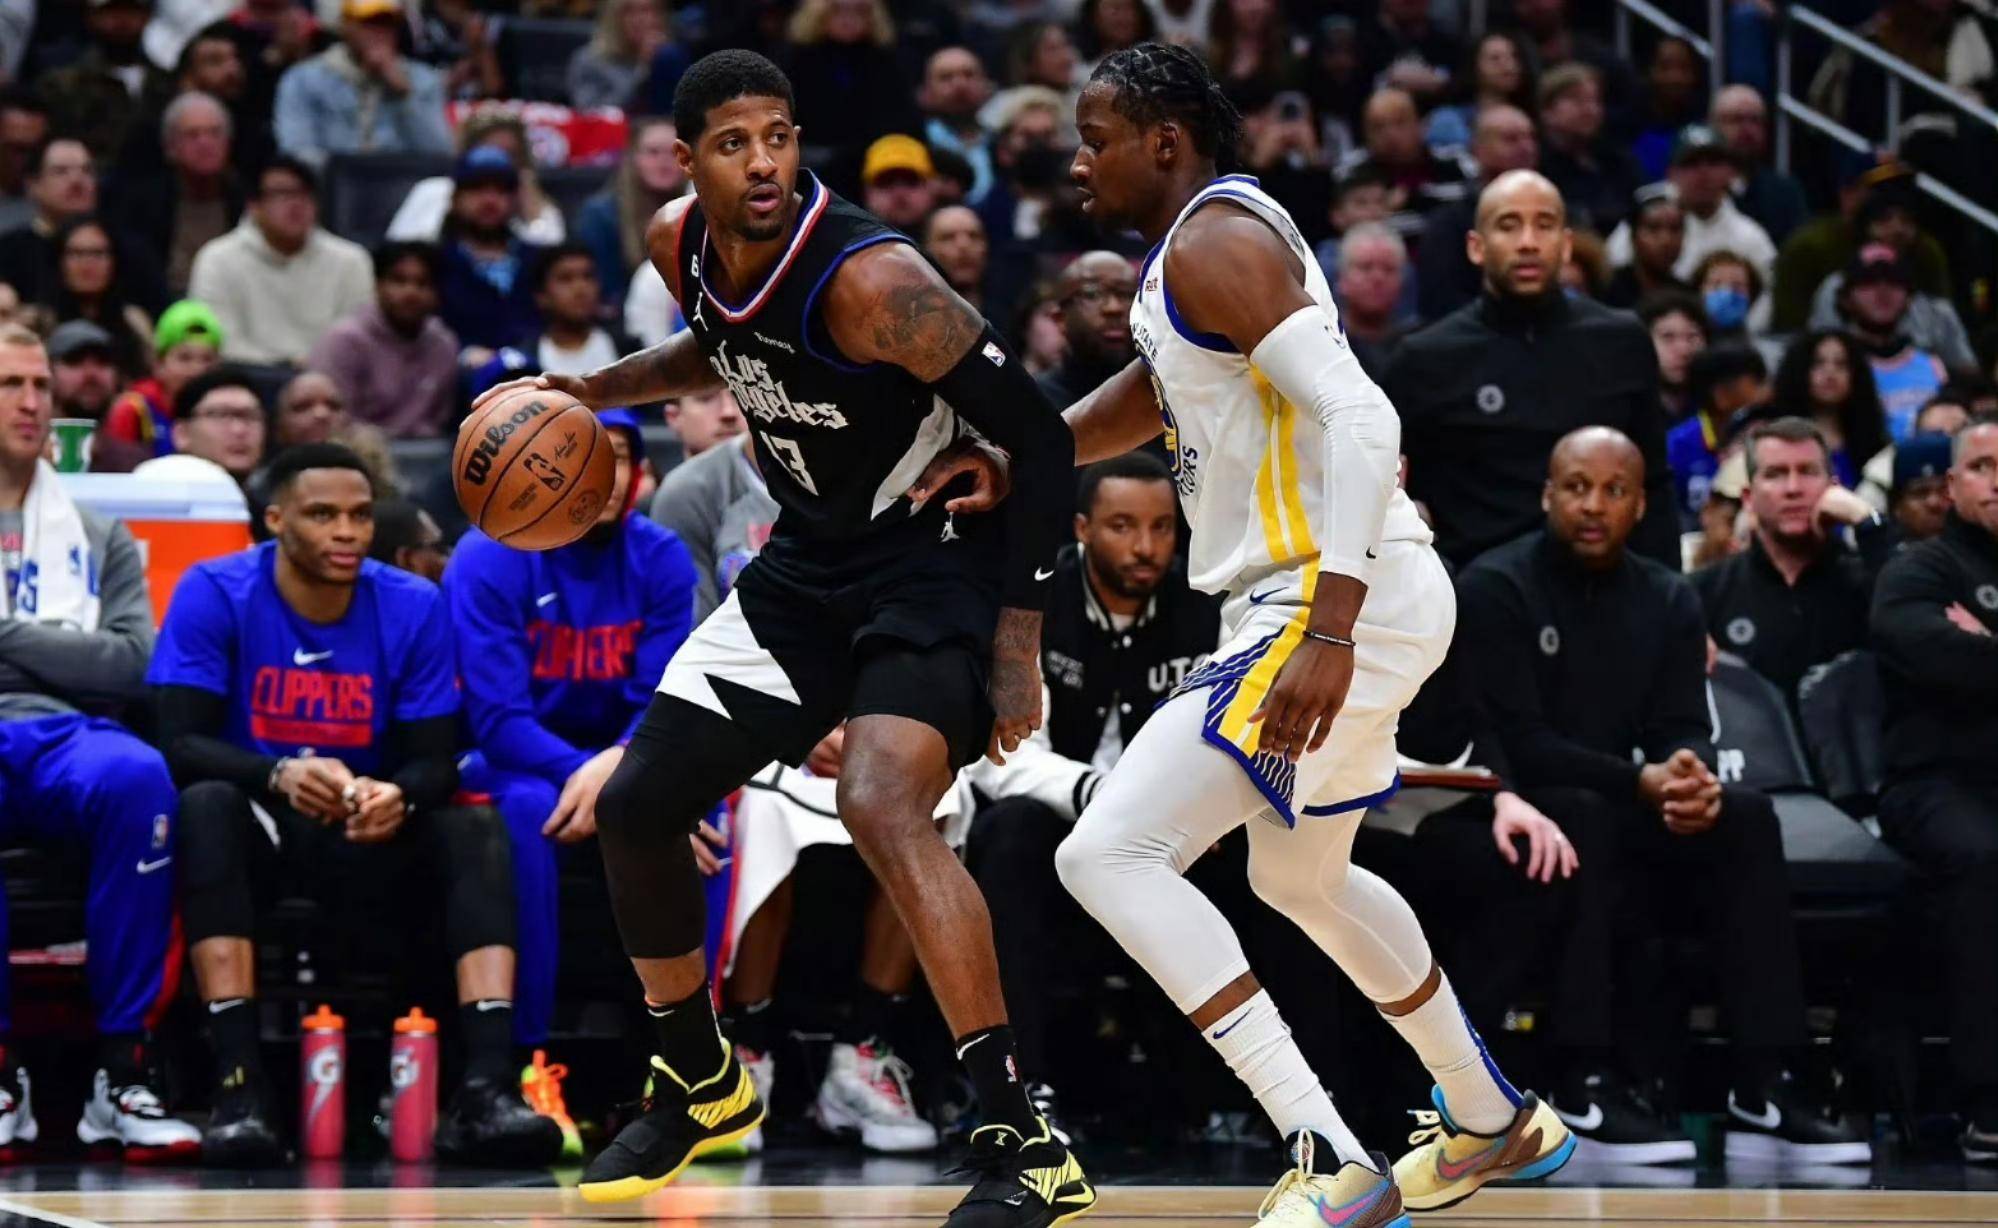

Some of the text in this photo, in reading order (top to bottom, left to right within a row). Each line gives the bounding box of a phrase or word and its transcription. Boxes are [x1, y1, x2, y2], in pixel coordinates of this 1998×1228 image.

[691, 254, 699, 277] 6
[465, 401, 549, 486] Wilson
[759, 429, 819, 496] 13
[253, 666, 374, 719] CLIPPERS
